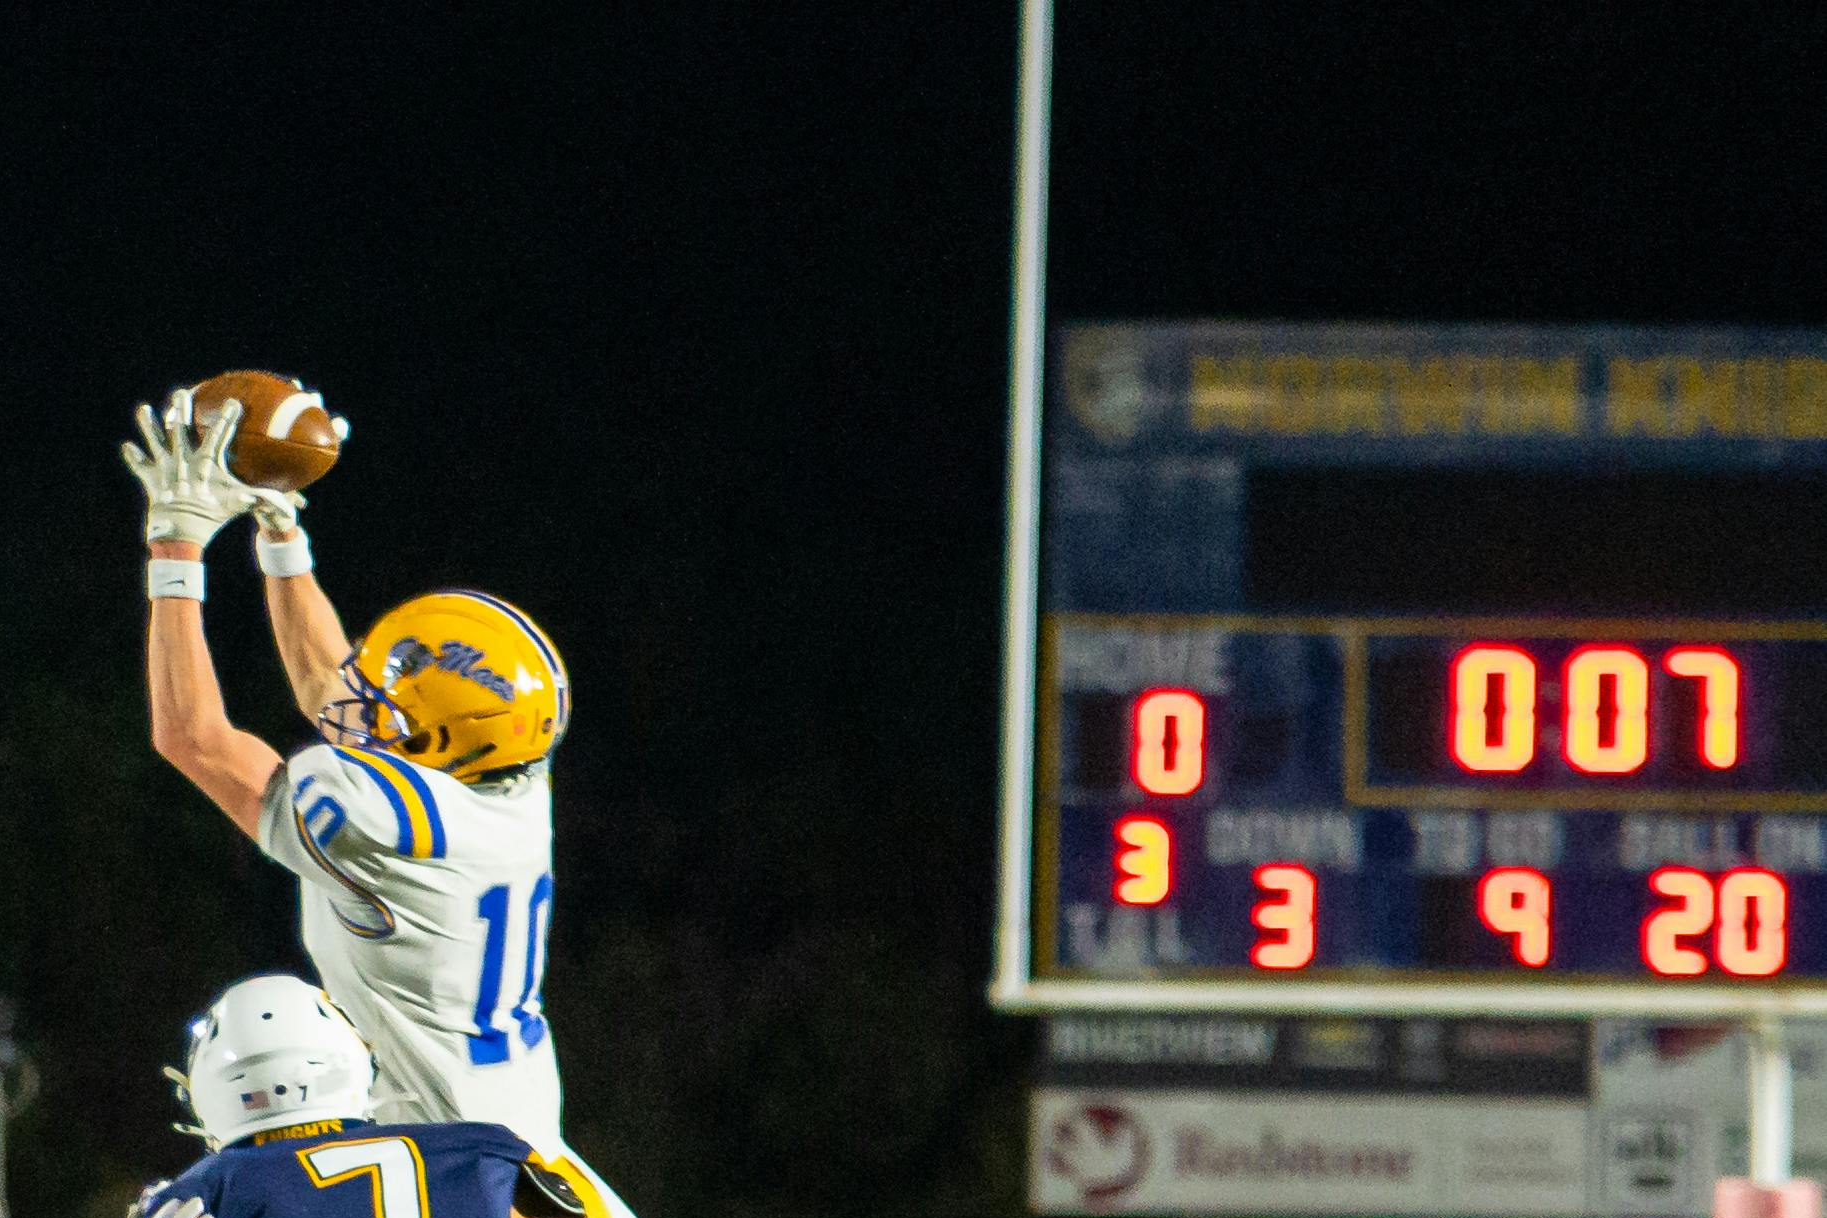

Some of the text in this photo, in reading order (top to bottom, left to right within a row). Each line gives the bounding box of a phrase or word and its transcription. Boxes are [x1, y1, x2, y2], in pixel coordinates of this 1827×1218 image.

[1131, 686, 1207, 797] 0
[1112, 816, 1173, 906] 3
[1249, 862, 1318, 971] 3
[1477, 865, 1553, 968] 9
[1640, 865, 1789, 976] 20
